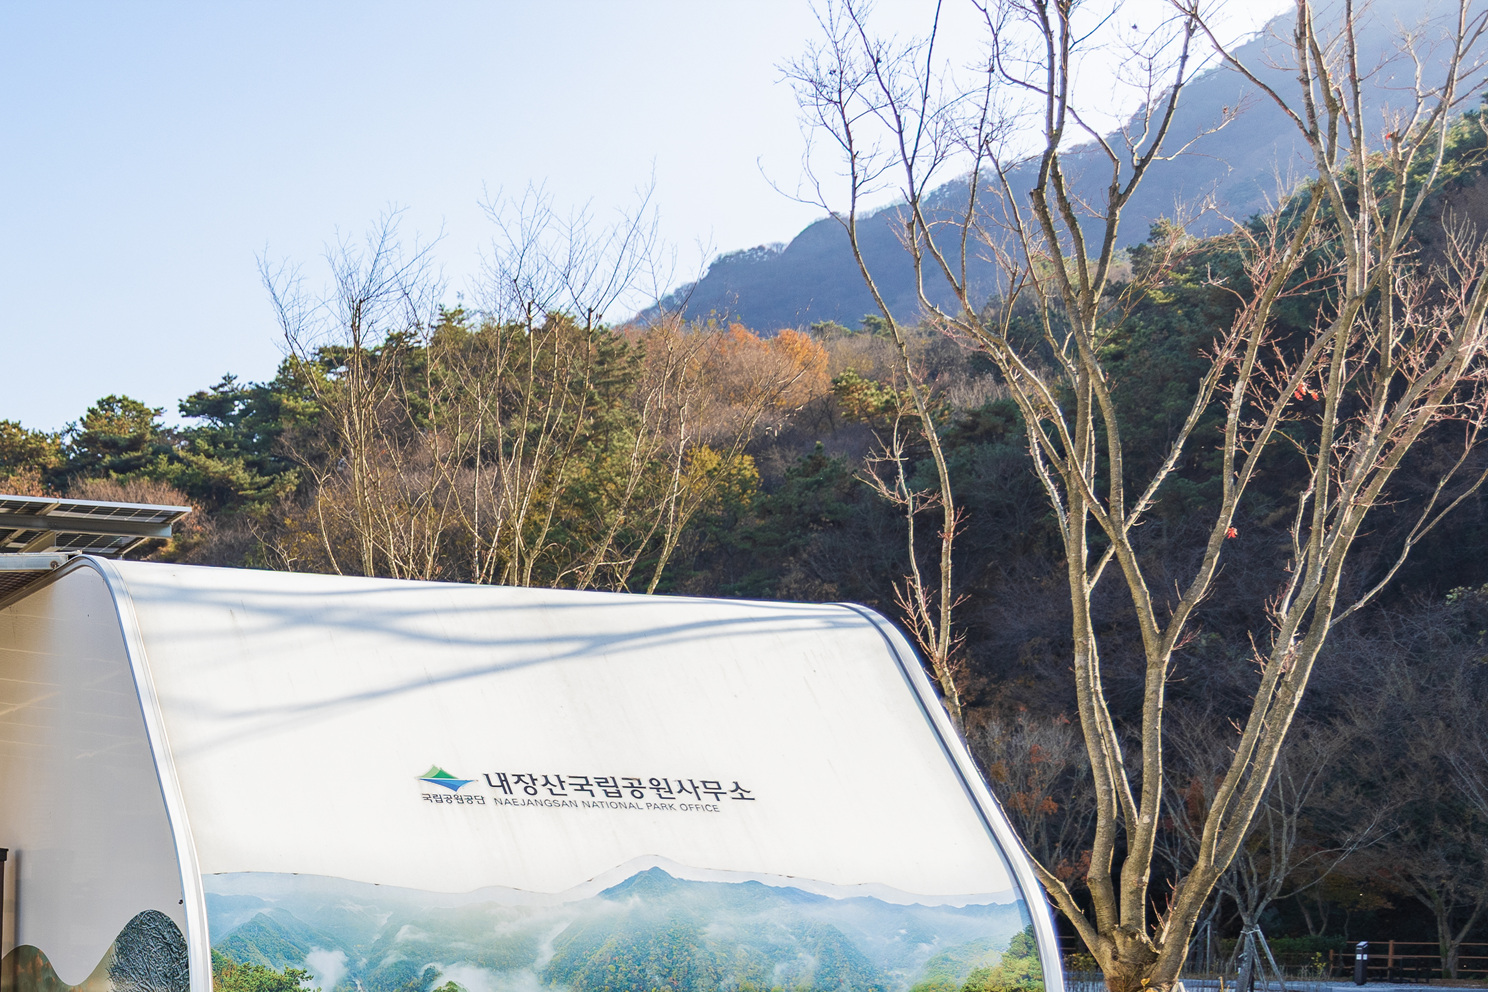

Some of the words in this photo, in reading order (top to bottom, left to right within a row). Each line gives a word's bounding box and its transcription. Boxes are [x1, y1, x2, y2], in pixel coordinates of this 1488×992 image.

[483, 772, 755, 801] 내장산국립공원사무소
[422, 793, 485, 805] 국립공원공단
[494, 798, 578, 808] NAEJANGSAN
[582, 801, 643, 810] NATIONAL
[646, 803, 676, 811] PARK
[680, 804, 720, 812] OFFICE
